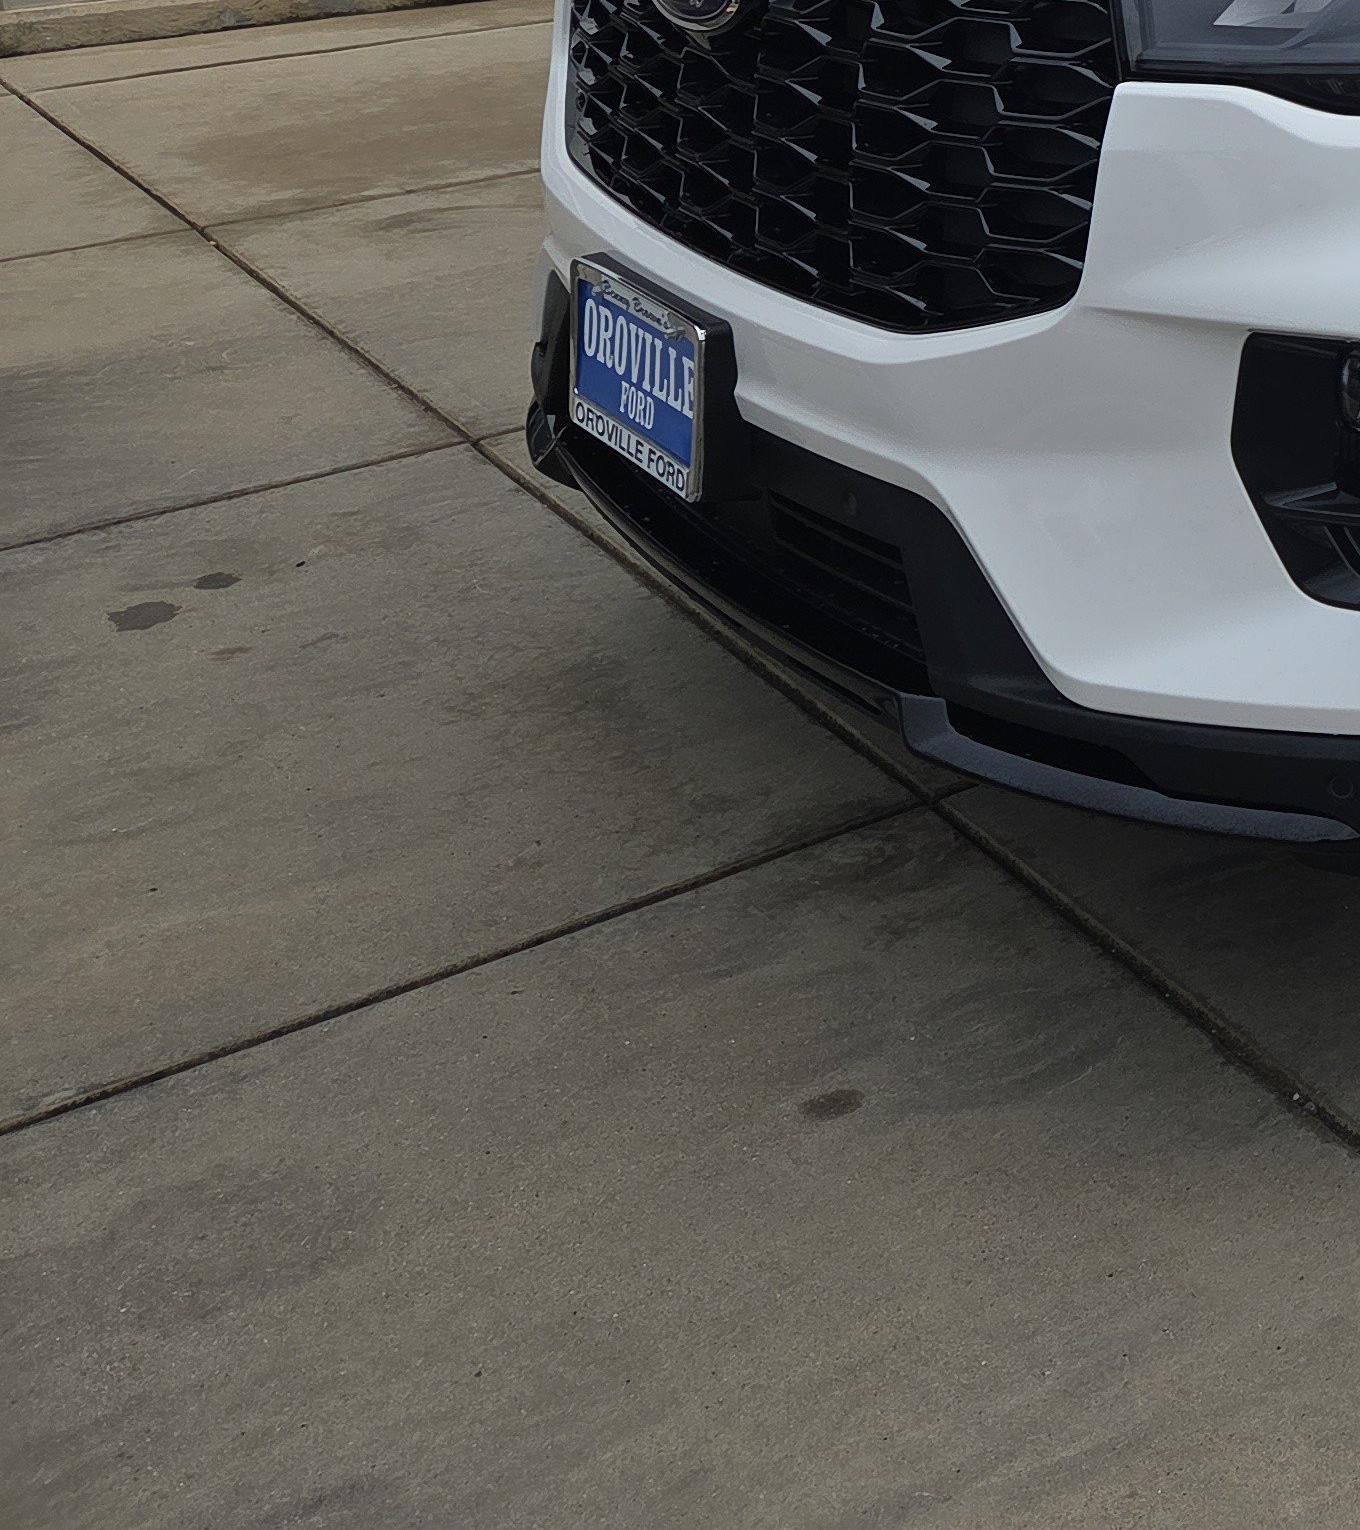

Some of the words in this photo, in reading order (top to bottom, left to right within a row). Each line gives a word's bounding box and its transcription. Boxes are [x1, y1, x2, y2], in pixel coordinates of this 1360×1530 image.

[583, 298, 695, 420] OROVILLE
[575, 401, 645, 464] OROVILLE
[646, 447, 686, 492] FORD
[619, 380, 655, 430] FORD
